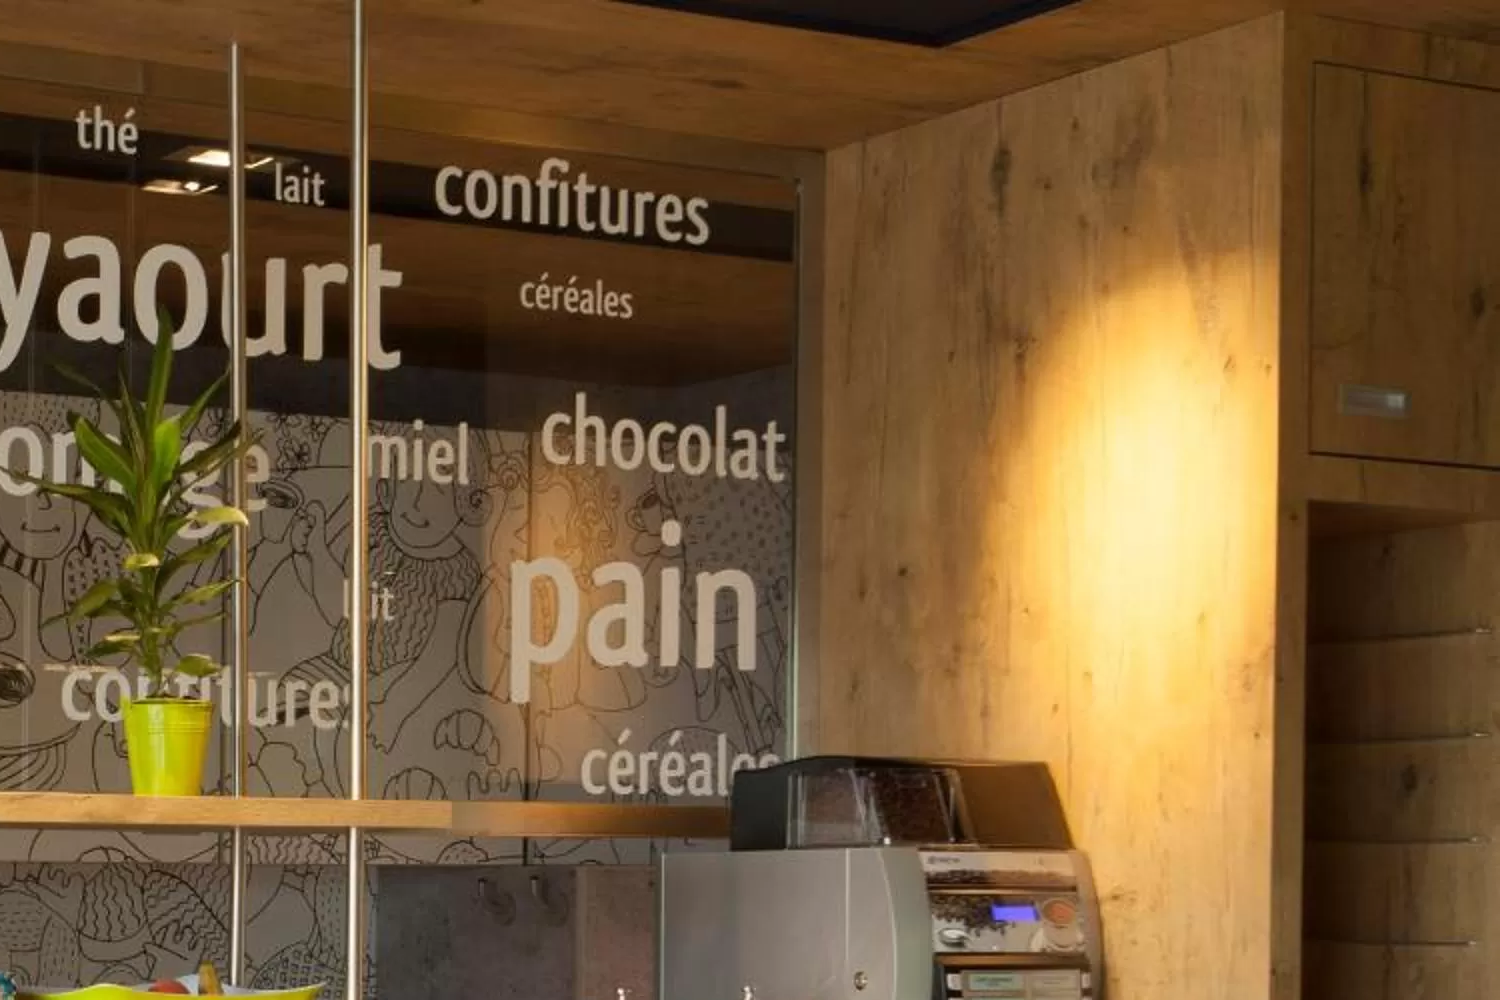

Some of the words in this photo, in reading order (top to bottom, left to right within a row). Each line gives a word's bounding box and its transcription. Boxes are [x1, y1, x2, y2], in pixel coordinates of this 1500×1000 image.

[76, 105, 138, 156] thé
[275, 163, 325, 207] lait
[435, 158, 709, 245] confitures
[520, 272, 633, 320] céréales
[368, 418, 469, 485] miel
[541, 392, 786, 484] chocolat
[343, 579, 395, 622] lit
[509, 520, 757, 703] pain
